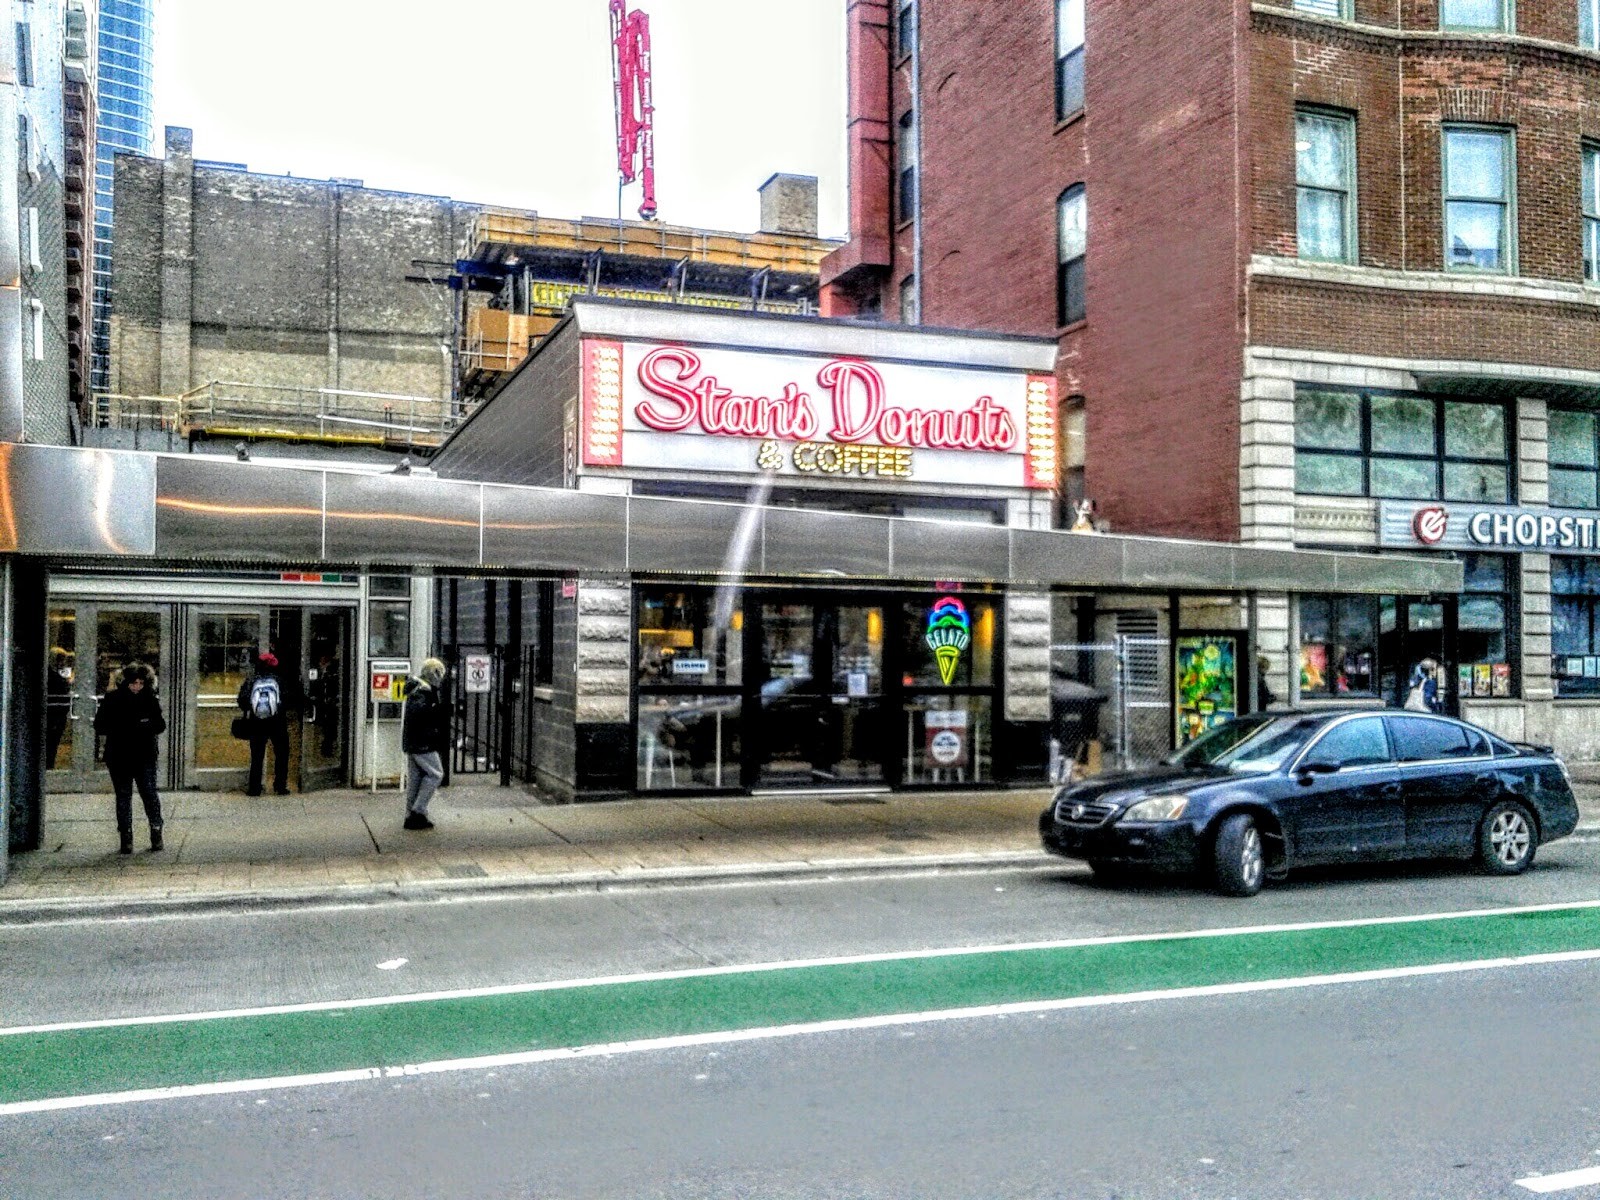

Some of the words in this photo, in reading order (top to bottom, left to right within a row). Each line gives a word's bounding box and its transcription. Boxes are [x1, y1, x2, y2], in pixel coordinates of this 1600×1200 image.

[635, 347, 818, 439] Stan's
[817, 360, 1017, 451] Donuts
[758, 440, 782, 469] &
[793, 442, 913, 477] COFFEE
[925, 628, 971, 650] GELATO
